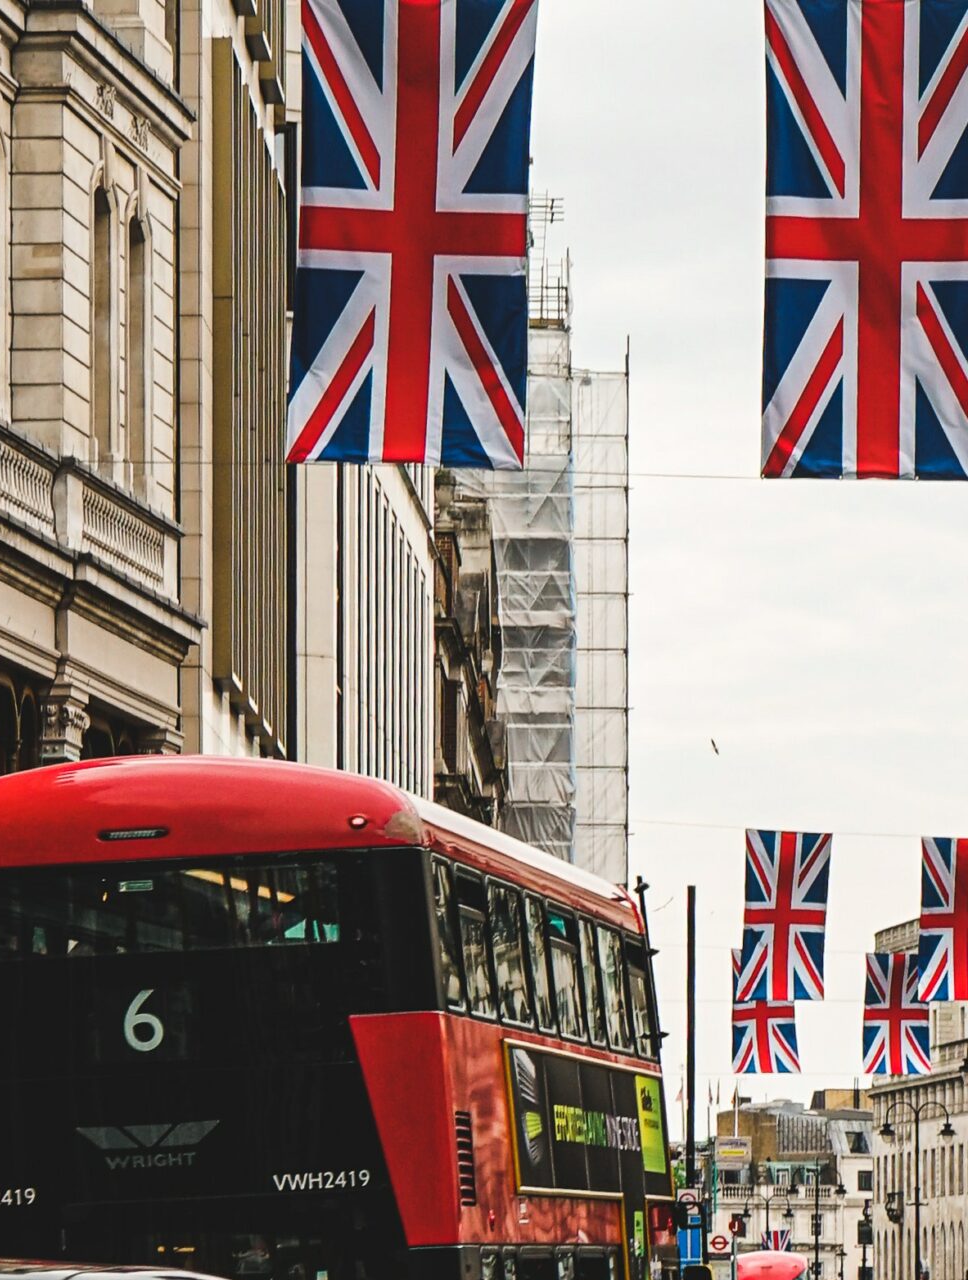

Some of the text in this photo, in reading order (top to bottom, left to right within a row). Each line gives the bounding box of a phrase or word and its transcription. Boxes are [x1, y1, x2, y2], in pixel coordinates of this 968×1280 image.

[123, 988, 164, 1052] 6
[105, 1152, 196, 1170] WRIGHT
[273, 1170, 370, 1191] VWH2419
